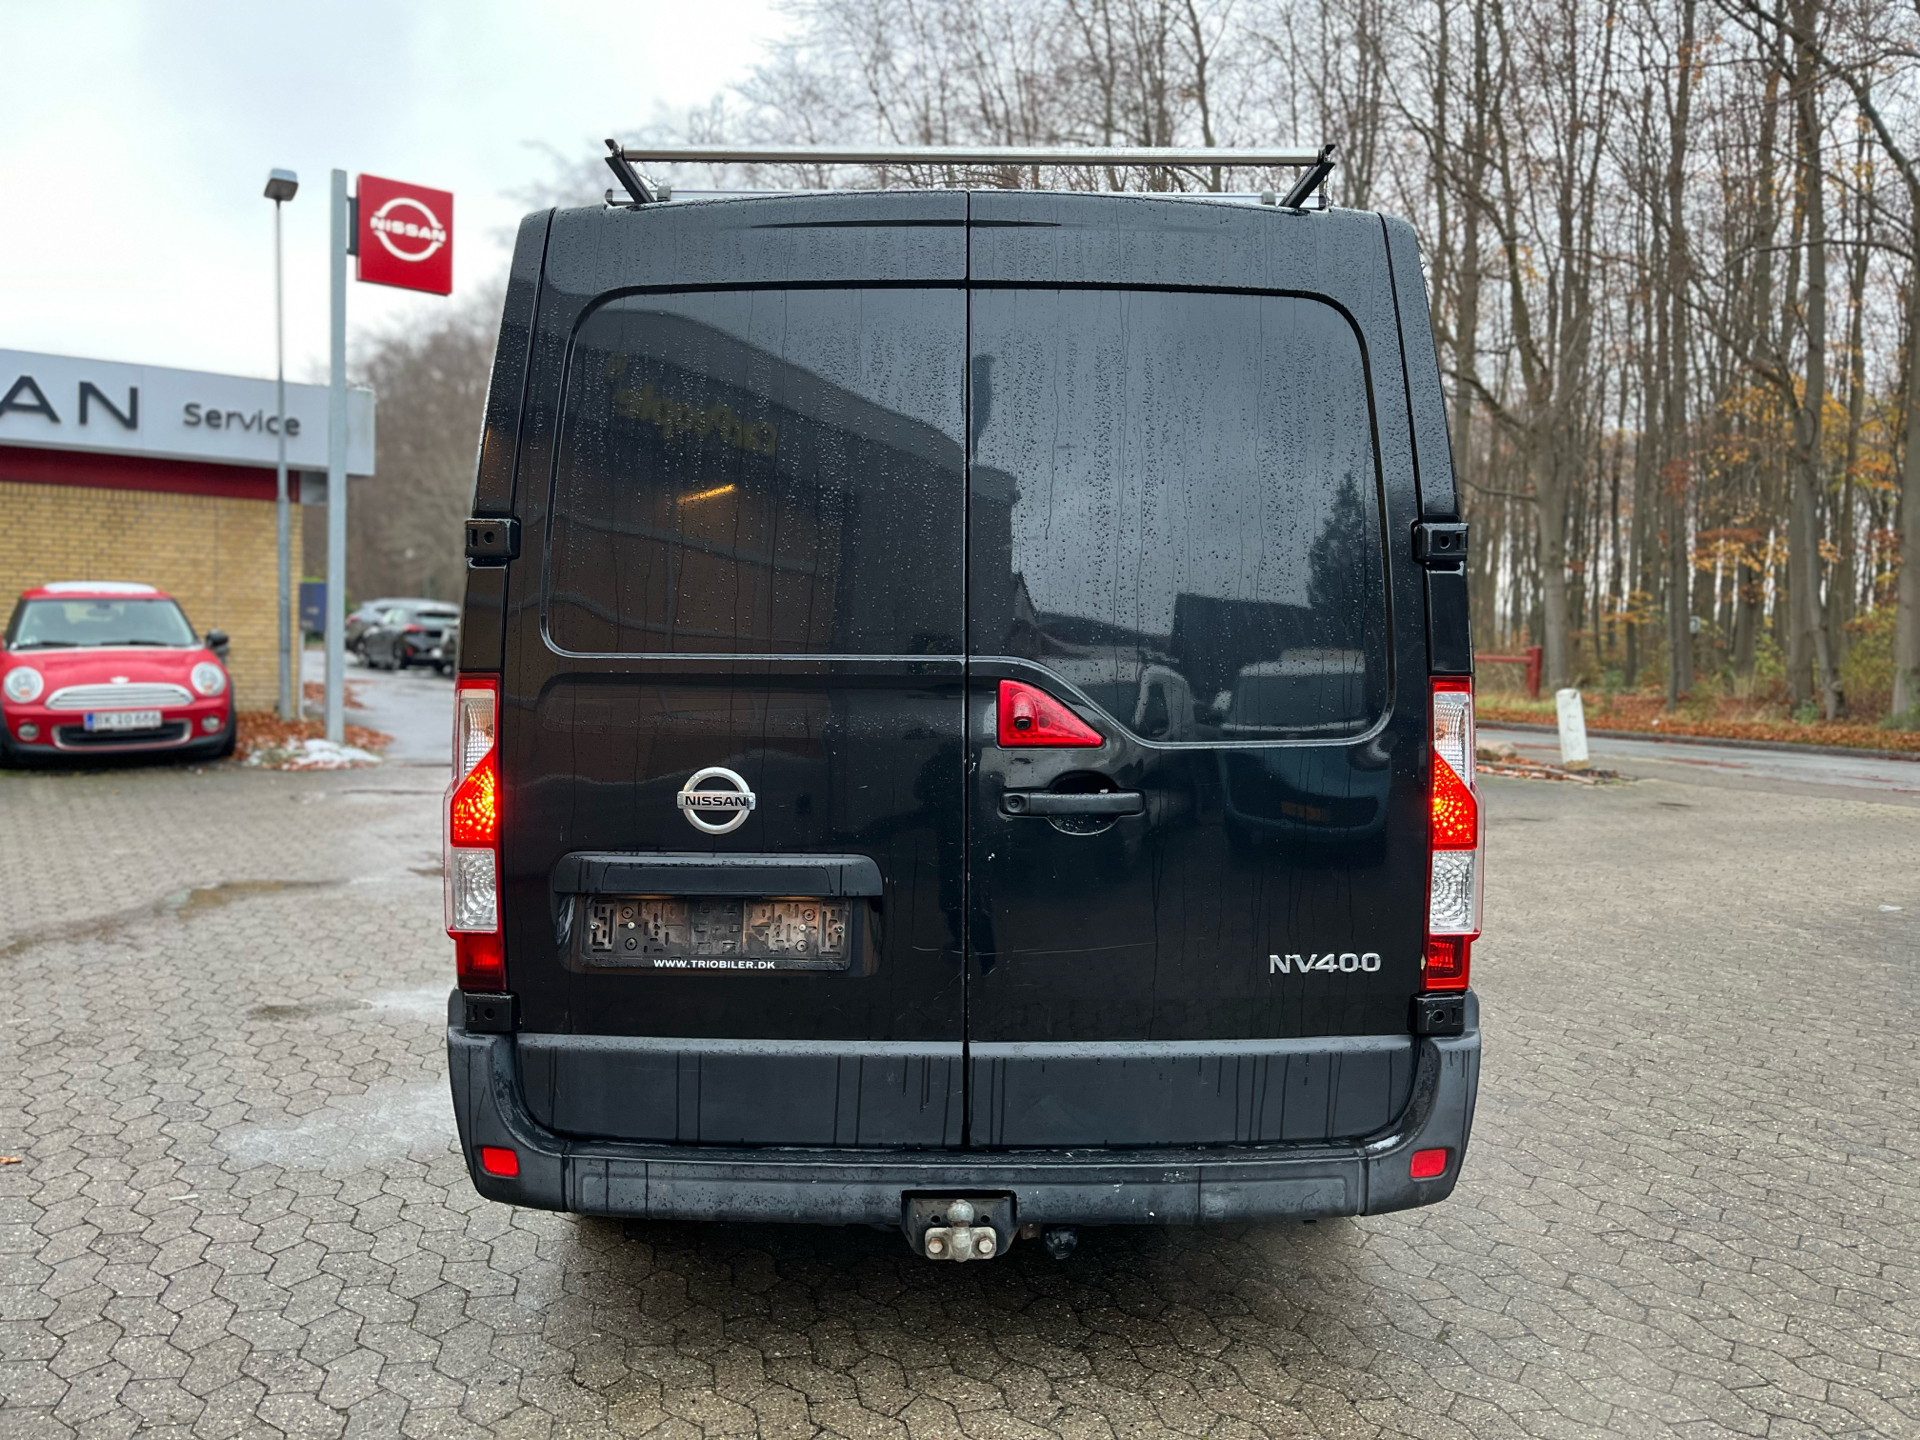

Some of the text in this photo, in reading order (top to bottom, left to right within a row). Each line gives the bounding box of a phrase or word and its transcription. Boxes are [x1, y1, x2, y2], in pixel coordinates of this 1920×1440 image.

[369, 216, 447, 243] NISSAN
[183, 403, 301, 436] Service
[685, 795, 747, 807] NISSAN
[653, 959, 776, 970] WWW.TRIOBILER.DK
[1269, 952, 1381, 974] NV400
